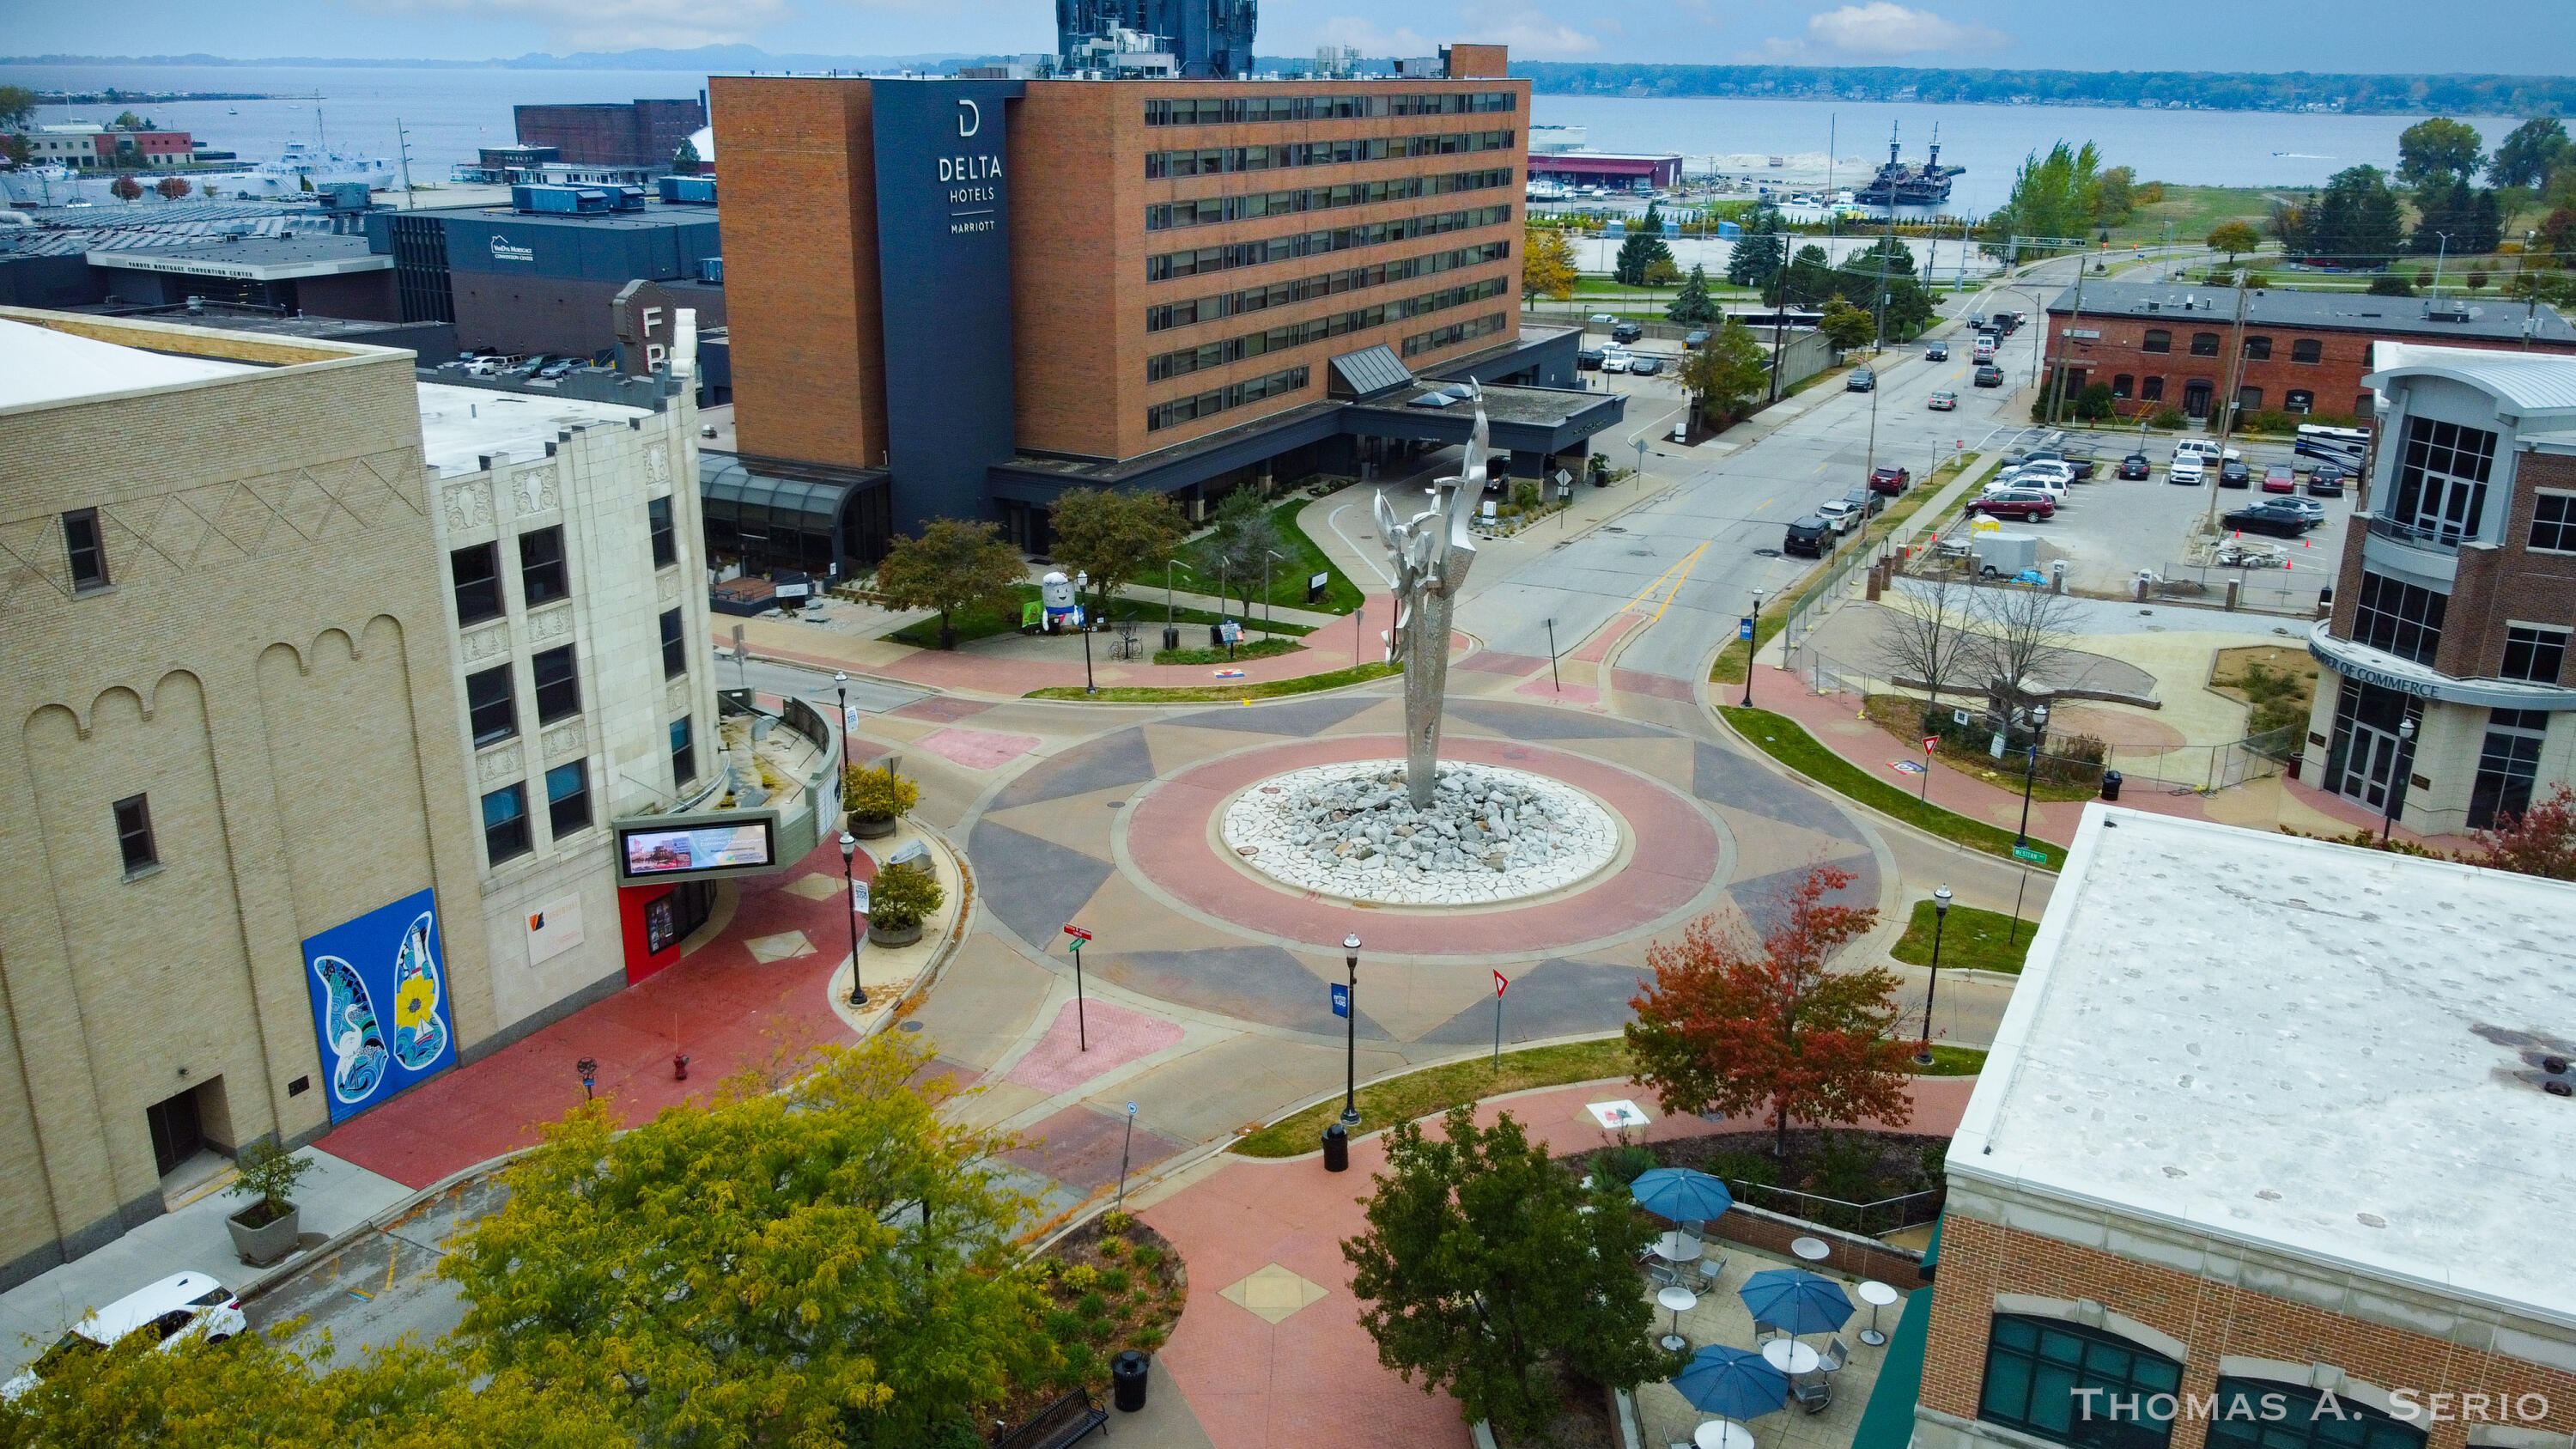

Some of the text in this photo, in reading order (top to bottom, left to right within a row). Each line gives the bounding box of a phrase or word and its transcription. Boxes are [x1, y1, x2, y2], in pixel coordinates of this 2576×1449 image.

[939, 155, 1002, 182] DELTA
[950, 186, 994, 204] HOTELS
[951, 220, 995, 234] MARRIOTT
[154, 264, 185, 272] MORTGAGE
[187, 266, 226, 276] CONVENTION
[2339, 661, 2355, 676] OF
[2357, 667, 2439, 698] COMMERCE
[2014, 849, 2038, 860] WESTERN
